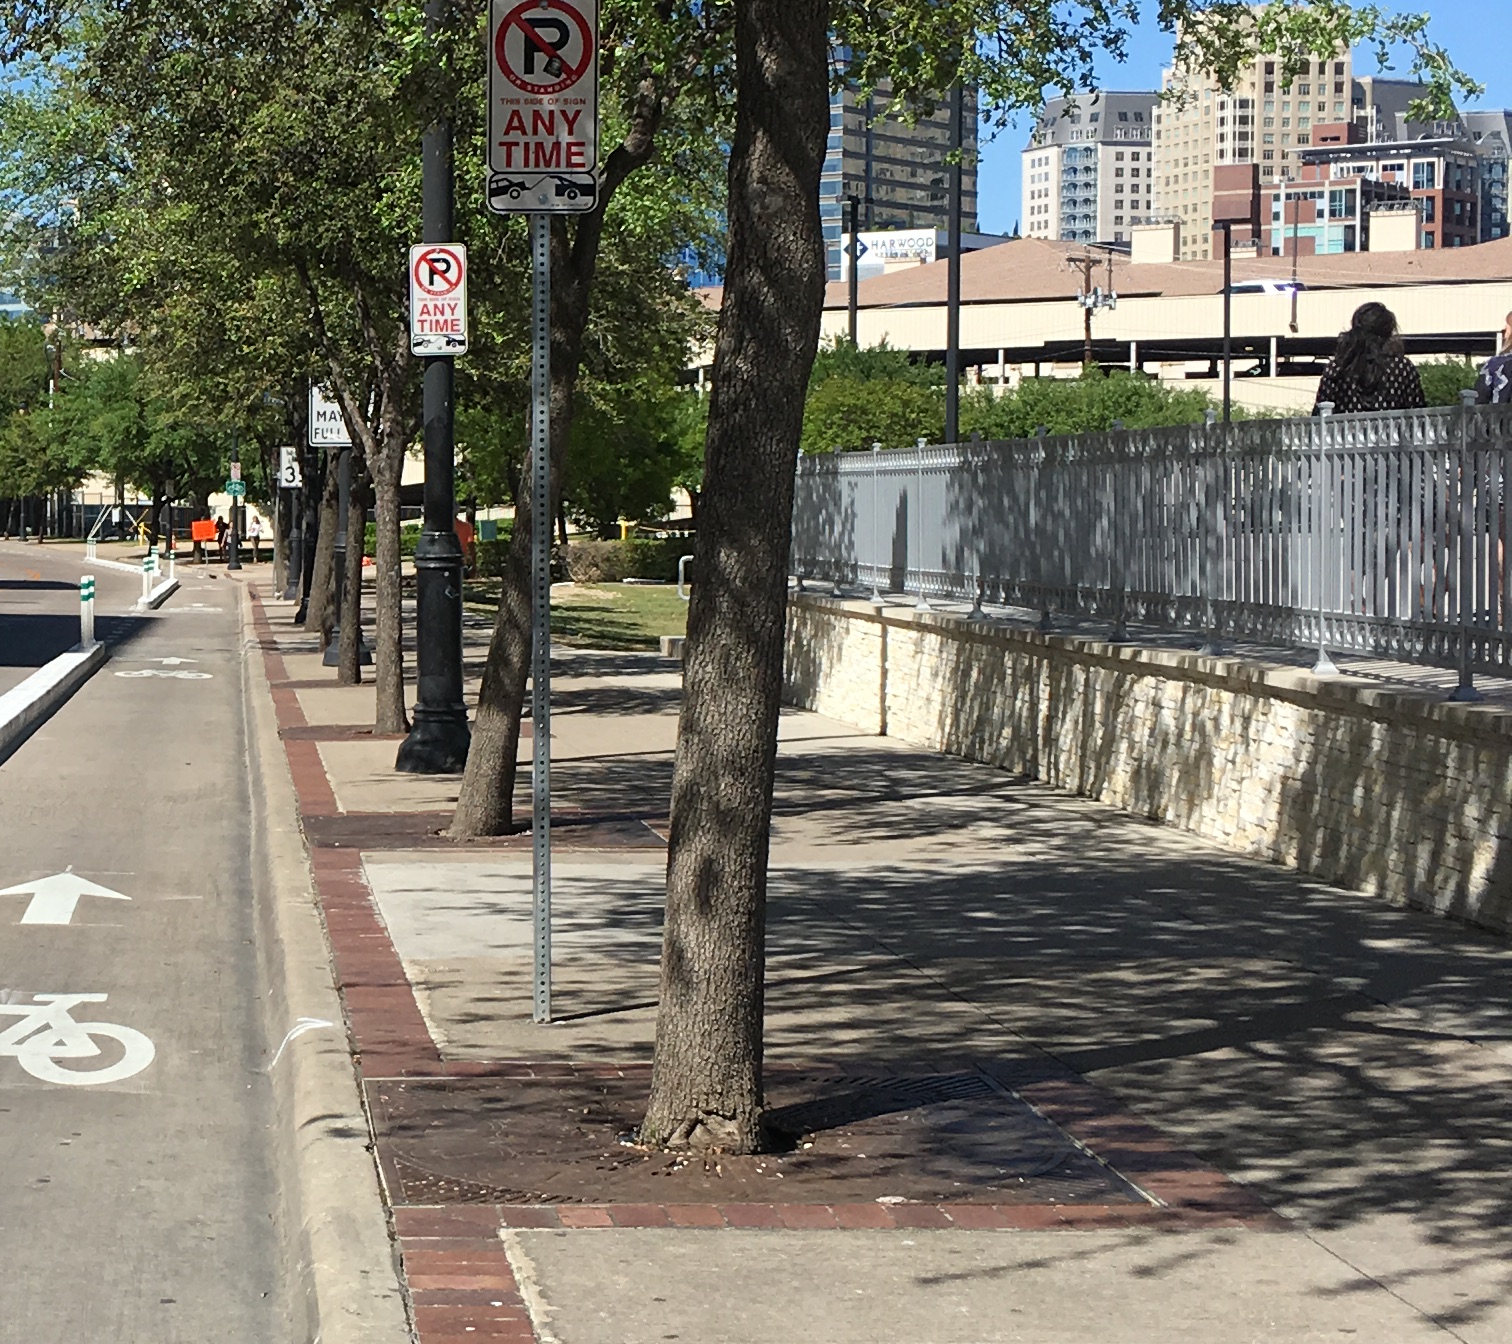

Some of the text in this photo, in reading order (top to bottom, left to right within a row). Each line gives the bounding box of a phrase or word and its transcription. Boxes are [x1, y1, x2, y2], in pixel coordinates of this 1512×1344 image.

[509, 74, 577, 93] OR STANDING
[500, 98, 586, 106] THIS SIDE OF SIGN
[503, 109, 582, 136] ANY
[498, 141, 586, 168] TIME
[871, 237, 934, 250] HARWOOD
[419, 302, 458, 317] ANY
[417, 318, 461, 333] TIME
